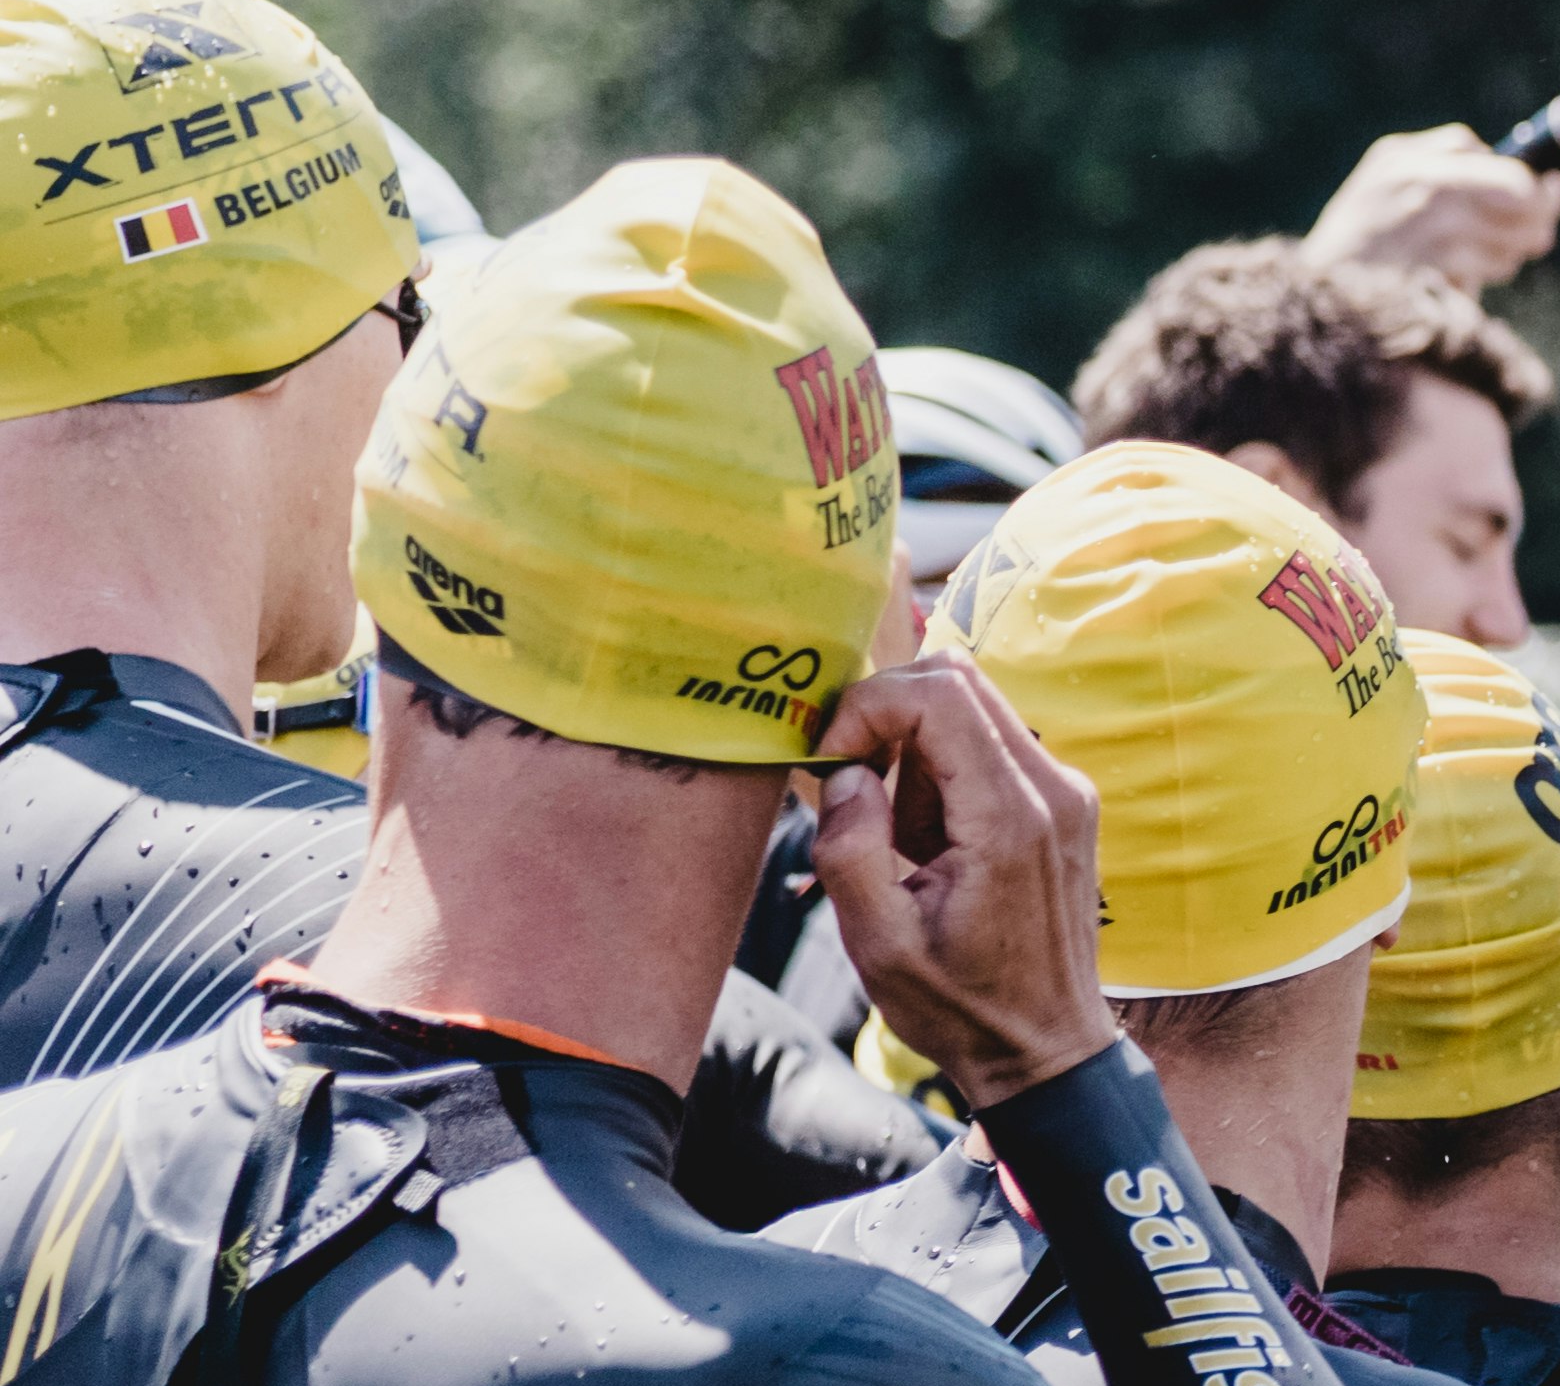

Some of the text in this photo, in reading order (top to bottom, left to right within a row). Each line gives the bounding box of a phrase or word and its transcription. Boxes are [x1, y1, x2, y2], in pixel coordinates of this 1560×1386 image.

[34, 66, 354, 208] XTERRA
[214, 142, 363, 228] BELGIUM
[817, 493, 861, 549] The
[405, 534, 504, 620] arena
[1337, 664, 1381, 719] The
[1267, 809, 1406, 915] INFINITRI
